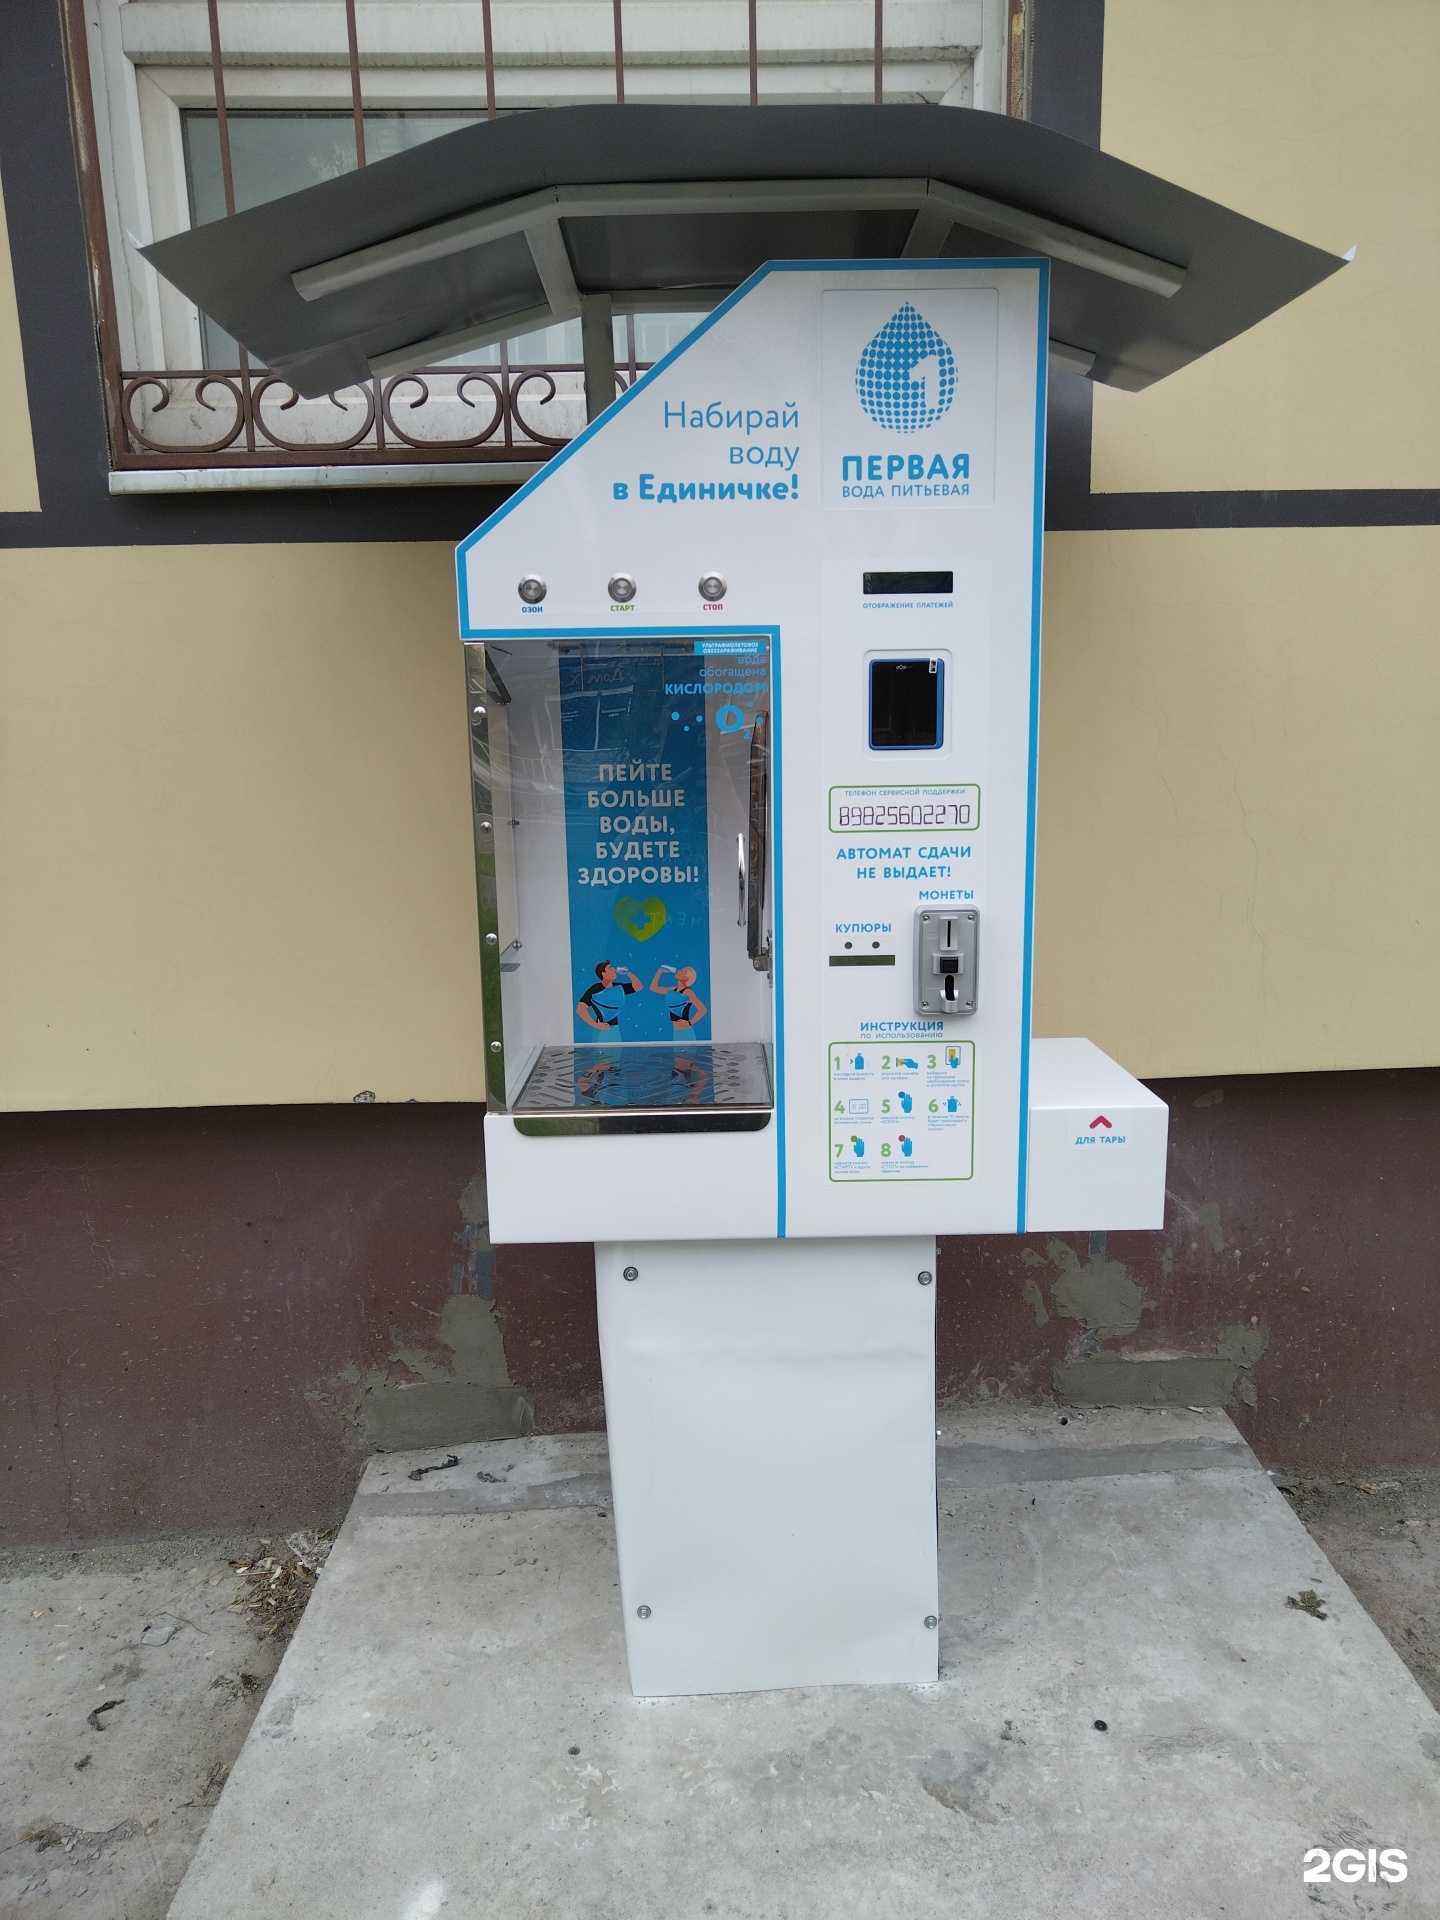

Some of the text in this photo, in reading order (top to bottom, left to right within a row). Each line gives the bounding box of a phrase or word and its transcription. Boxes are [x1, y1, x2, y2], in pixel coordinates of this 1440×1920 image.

[664, 400, 799, 435] Набирай
[729, 446, 799, 471] воду
[842, 453, 970, 481] ПЕРВАЯ
[613, 473, 799, 503] в Единичке!
[842, 483, 970, 499] ВОДА ПИТЬЕВАЯ
[521, 606, 543, 614] ОЗОН
[610, 604, 635, 612] СТАРТ
[703, 603, 724, 611] СТОП
[916, 600, 953, 608] ПЛАТЕЖЕЙ
[600, 759, 673, 783] ПЕЙТЕ
[587, 788, 686, 809] БОЛЬШЕ
[923, 788, 966, 796] ПОДДЕРЖКИ
[839, 804, 971, 826] 89825602270
[600, 815, 676, 835] ВОДЫ,
[595, 840, 681, 861] БУДЕТЕ
[836, 846, 972, 860] АВТОМАТ СДАЧИ
[578, 866, 700, 887] ЗДОРОВЫ!
[857, 865, 951, 880] НЕ ВЫДАЕТ!
[919, 889, 975, 900] МОНЕТЫ
[835, 923, 892, 934] КУПЮРЫ
[860, 1021, 944, 1033] ИНСТРУКЦИЯ
[834, 1056, 841, 1070] 1
[881, 1055, 891, 1070] 2
[927, 1054, 937, 1069] 3
[834, 1100, 846, 1114] 4
[881, 1099, 891, 1113] 5
[928, 1098, 939, 1113] 6
[1075, 1136, 1126, 1144] ДЛЯ ТАРЫ
[834, 1143, 844, 1158] 7
[880, 1143, 892, 1157] 8
